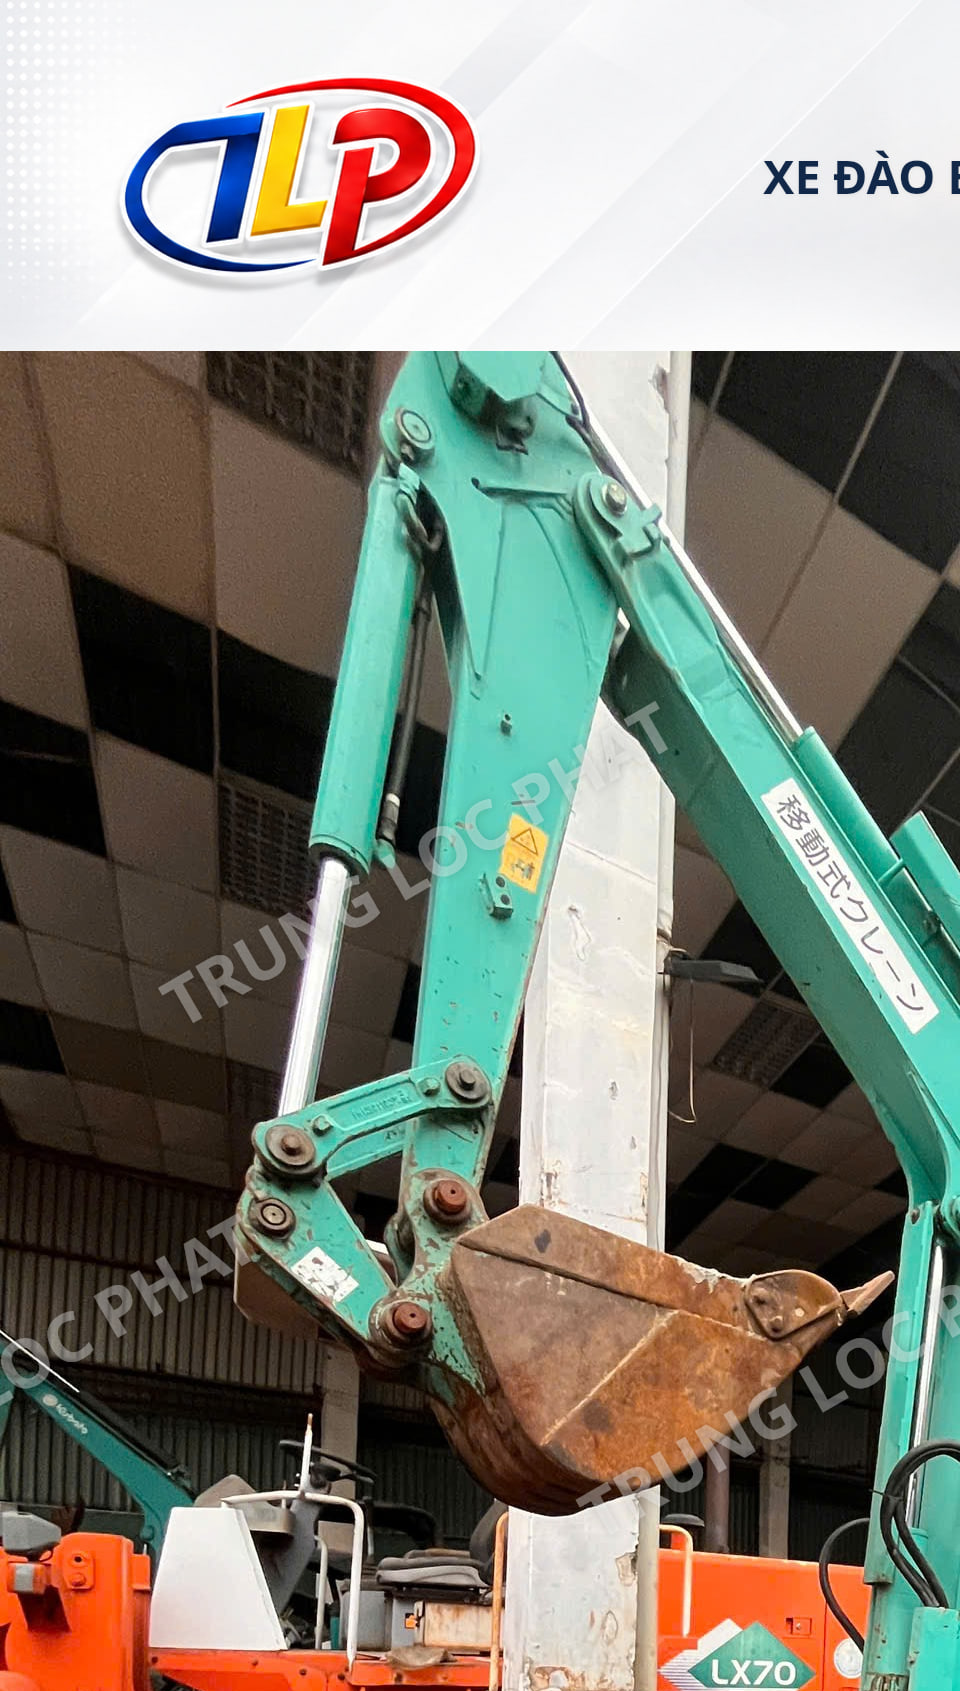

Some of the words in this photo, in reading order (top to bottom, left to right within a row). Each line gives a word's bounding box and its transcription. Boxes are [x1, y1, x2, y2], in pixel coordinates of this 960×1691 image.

[777, 794, 924, 1011] 移動式クレーン
[711, 1659, 797, 1686] LX70
